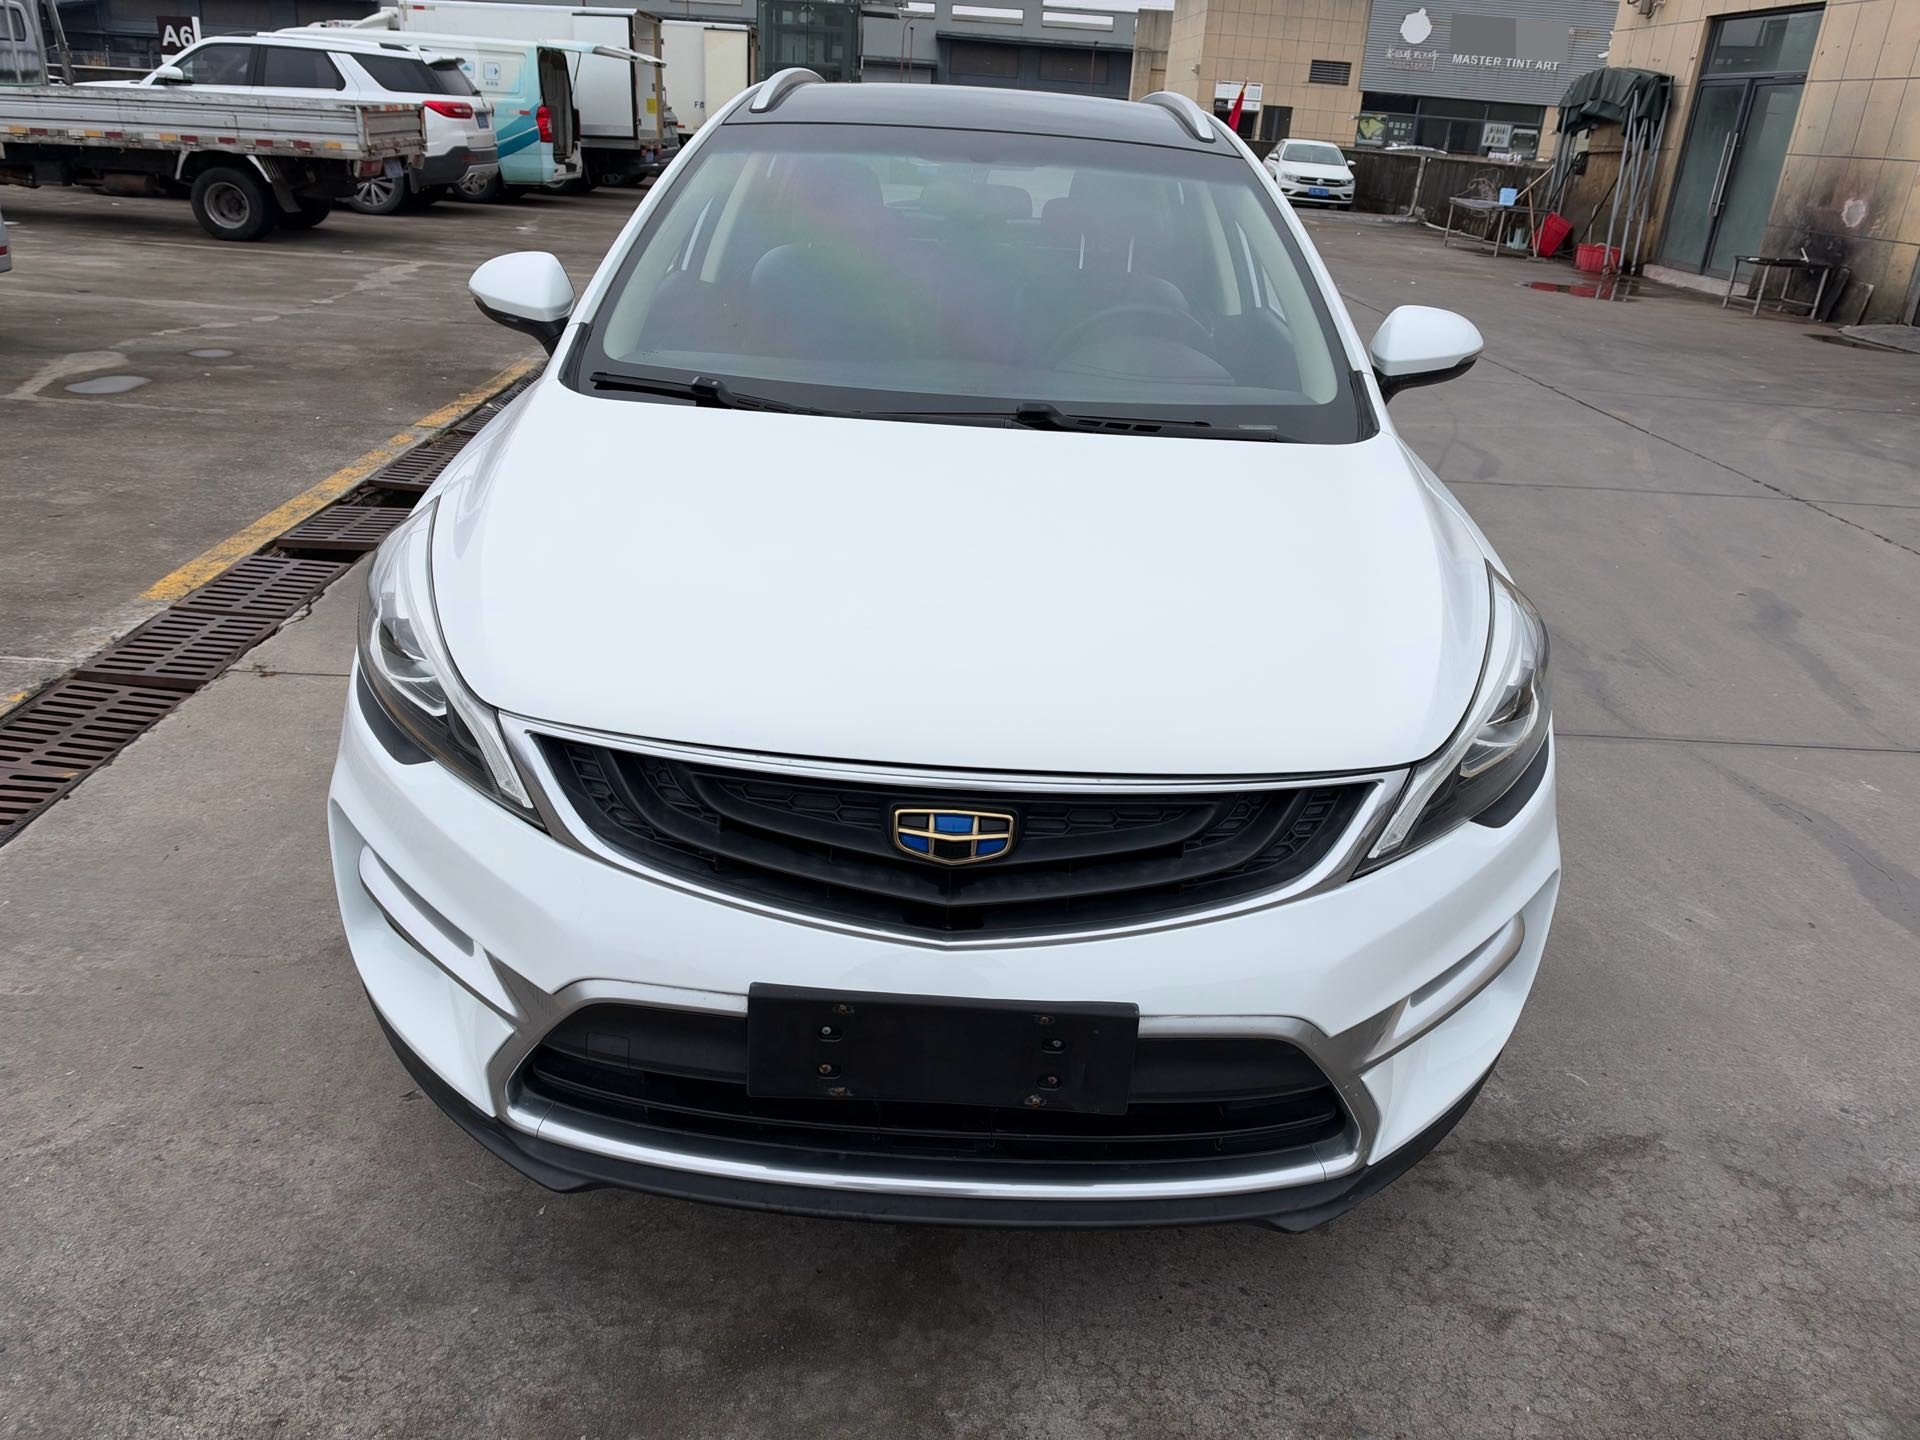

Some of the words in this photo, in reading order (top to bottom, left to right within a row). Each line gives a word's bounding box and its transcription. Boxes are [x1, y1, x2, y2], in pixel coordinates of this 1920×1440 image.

[162, 25, 194, 48] A6
[1452, 54, 1502, 66] MASTER
[1505, 58, 1532, 69] TINT
[1535, 60, 1560, 71] ART
